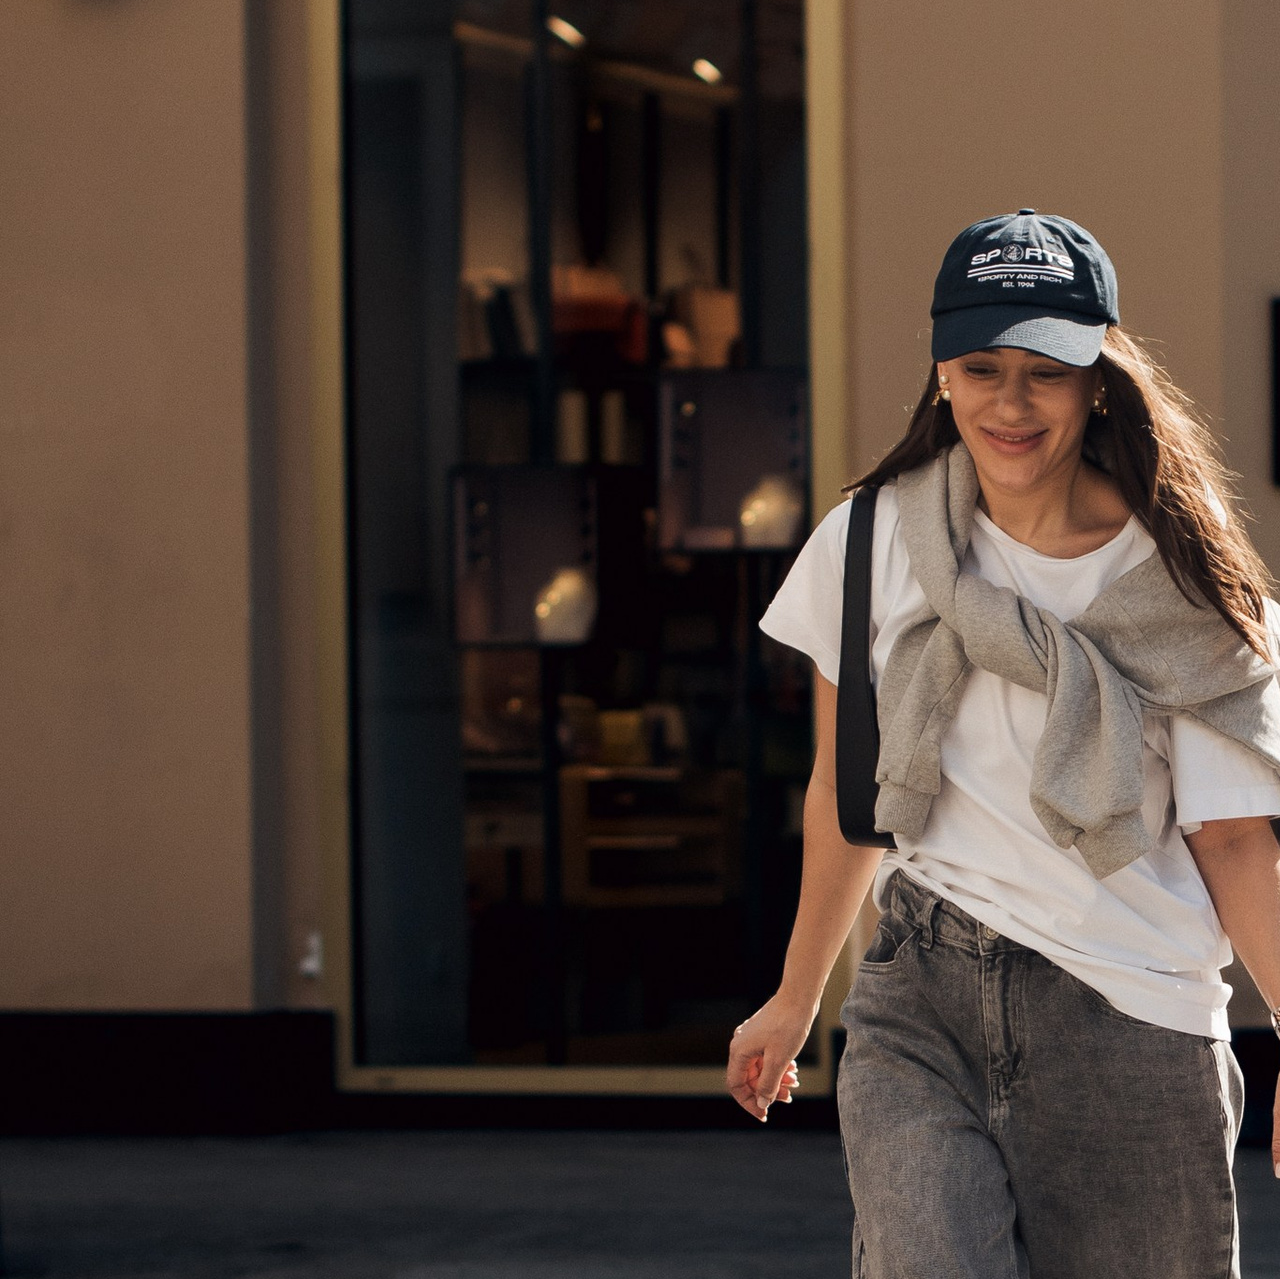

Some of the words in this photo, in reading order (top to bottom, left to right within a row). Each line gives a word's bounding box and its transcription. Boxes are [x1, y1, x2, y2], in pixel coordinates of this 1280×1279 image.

[971, 244, 1074, 267] SPORTS
[978, 273, 1015, 282] SPORTY
[1040, 274, 1062, 283] RICH
